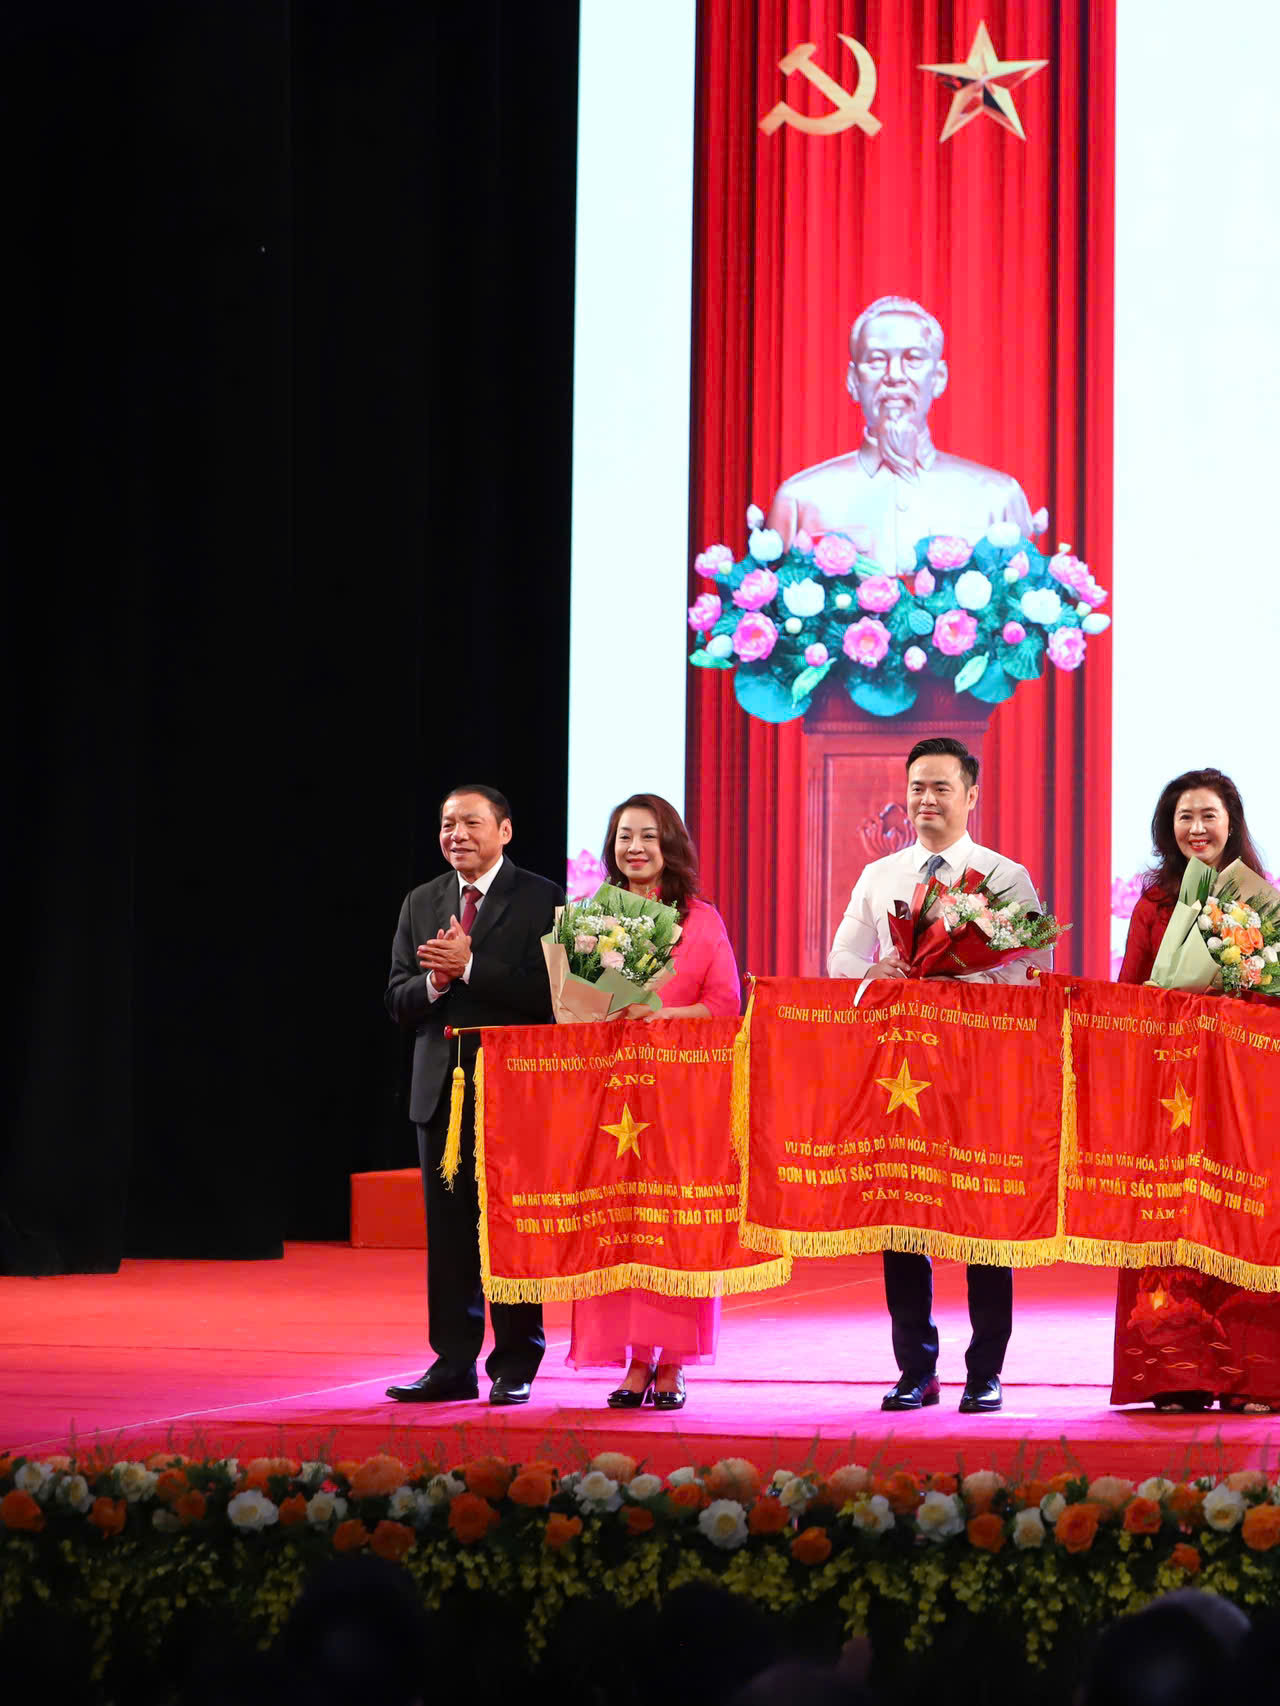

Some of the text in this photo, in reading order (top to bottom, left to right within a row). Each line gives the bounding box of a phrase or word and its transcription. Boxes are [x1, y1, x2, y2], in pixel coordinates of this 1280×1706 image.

[778, 1004, 809, 1022] CHÍNH
[811, 1004, 833, 1024] PHỦ
[833, 1007, 861, 1025] NƯỚC
[991, 1012, 1014, 1032] VIỆT
[1015, 1017, 1038, 1032] NAM
[507, 1055, 537, 1072] CHÍNH
[539, 1052, 559, 1072] PHỦ
[656, 1045, 677, 1063] CHỦ
[604, 1073, 656, 1091] ẶNG
[873, 1162, 909, 1180] TRONG
[903, 1191, 944, 1208] 2024
[704, 1208, 723, 1225] THI
